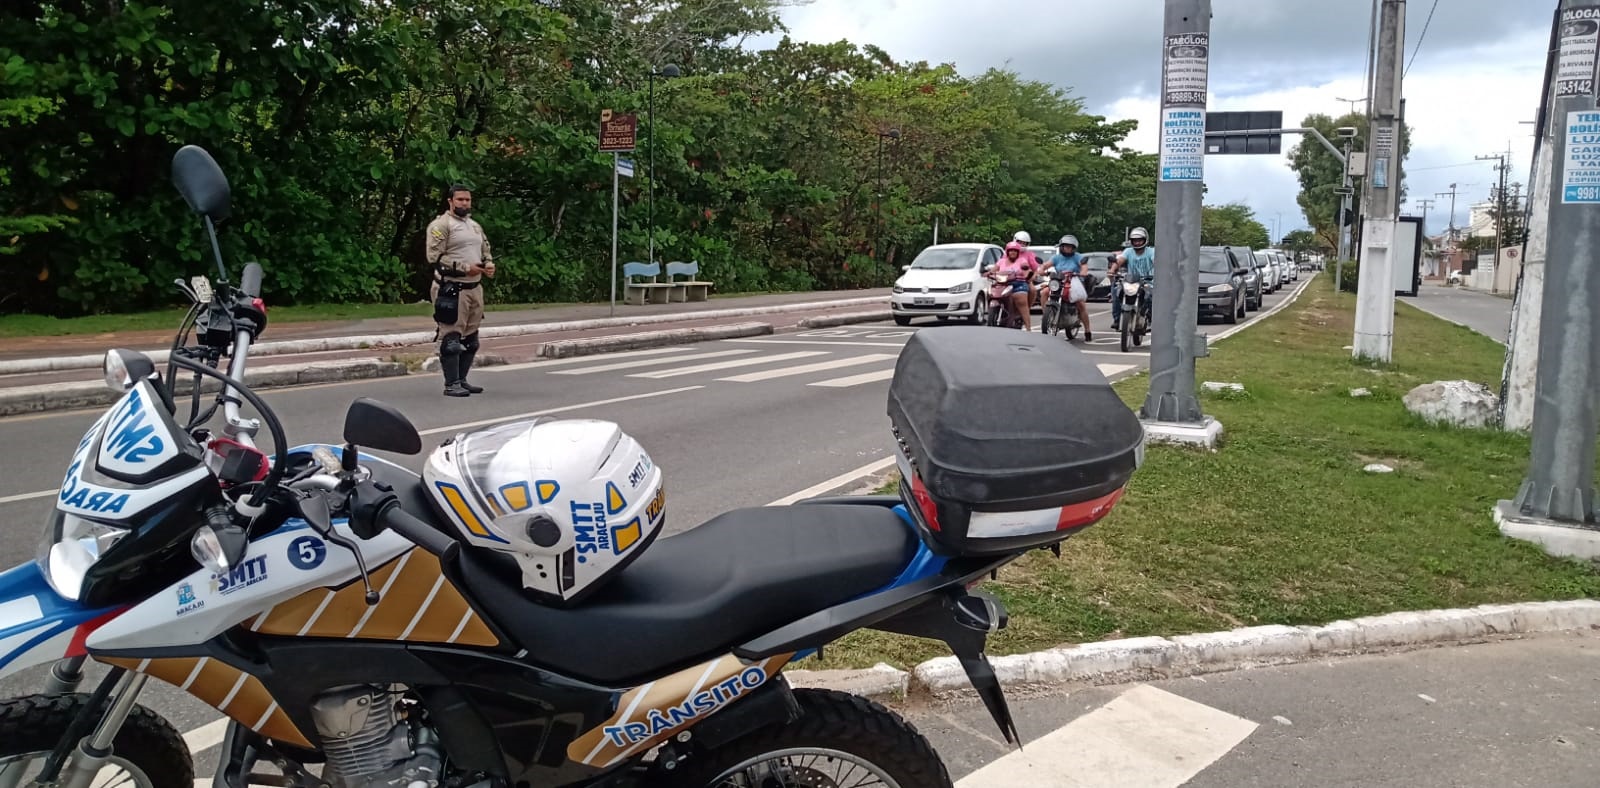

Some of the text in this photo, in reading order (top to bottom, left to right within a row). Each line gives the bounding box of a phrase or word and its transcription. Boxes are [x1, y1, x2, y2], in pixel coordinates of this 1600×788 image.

[628, 462, 646, 488] SMTT
[570, 500, 598, 554] SMTT
[593, 502, 610, 550] ARACAJU
[298, 540, 317, 563] 5
[218, 554, 268, 592] SMTT
[246, 574, 268, 586] ARACAJU
[176, 600, 205, 616] ARACAJU
[603, 665, 767, 748] TRÂNSITO
